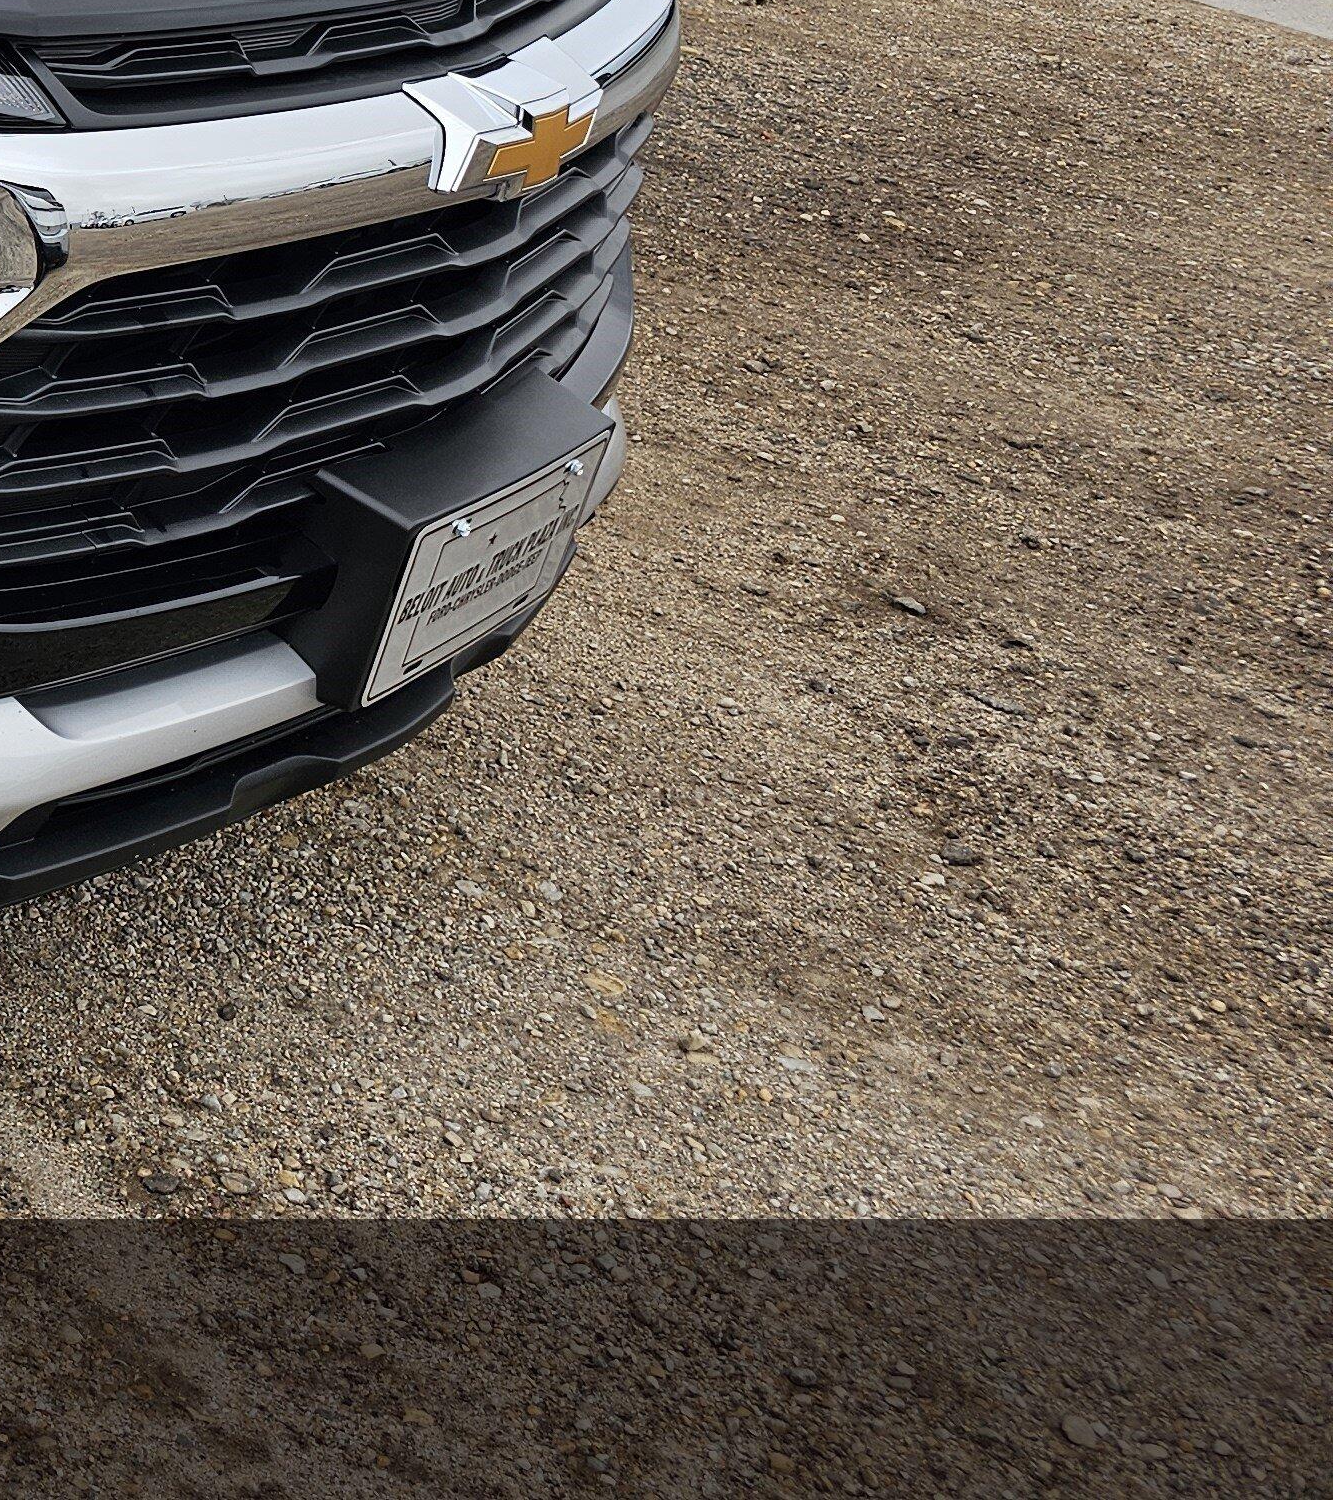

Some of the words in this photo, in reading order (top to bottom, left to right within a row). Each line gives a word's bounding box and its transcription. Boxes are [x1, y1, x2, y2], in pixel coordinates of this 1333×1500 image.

[397, 580, 449, 625] BELOIT
[442, 563, 481, 602] AUTO
[486, 537, 527, 577] TRUCK
[522, 516, 560, 554] PLAZA
